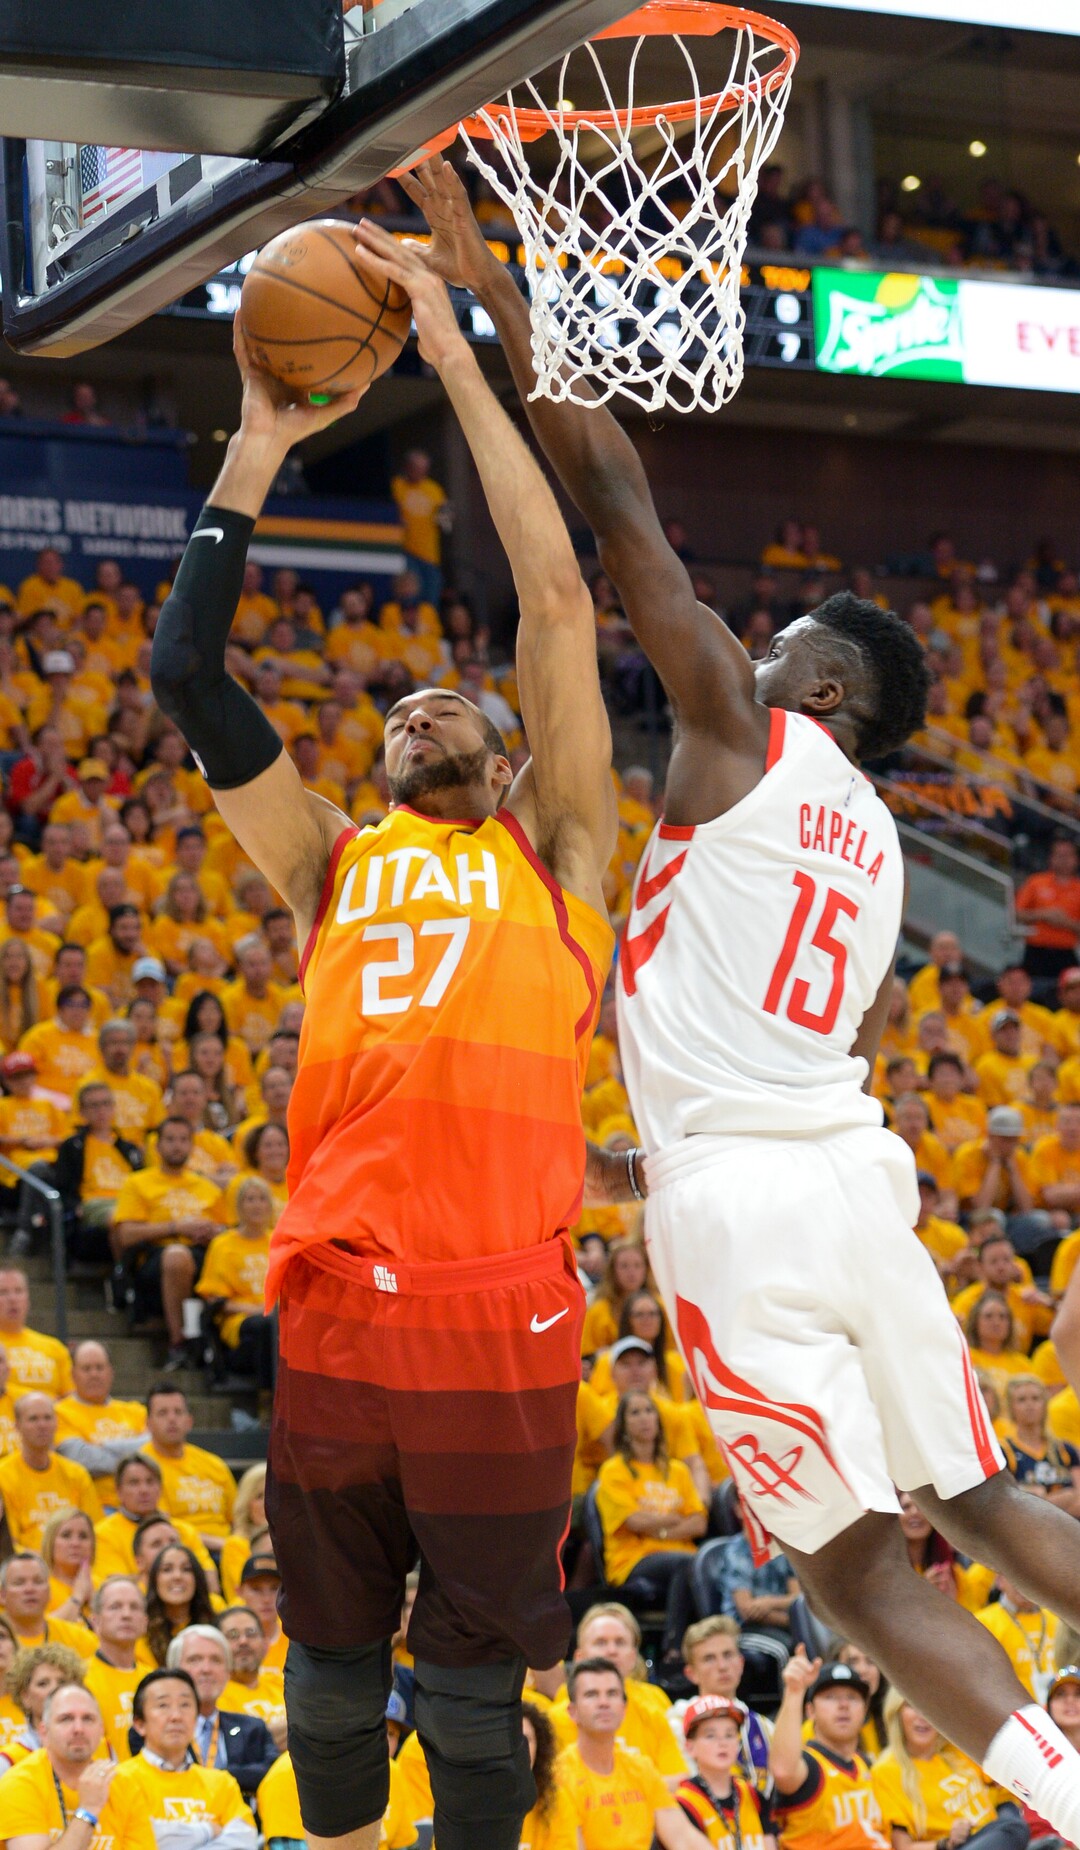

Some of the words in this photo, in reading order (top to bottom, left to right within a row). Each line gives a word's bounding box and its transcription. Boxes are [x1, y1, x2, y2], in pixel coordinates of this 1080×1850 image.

[777, 332, 800, 362] 7
[64, 501, 188, 540] NETWORK
[799, 803, 885, 886] CAPELA
[336, 847, 500, 924] UTAH
[361, 916, 471, 1016] 27
[762, 869, 860, 1035] 15
